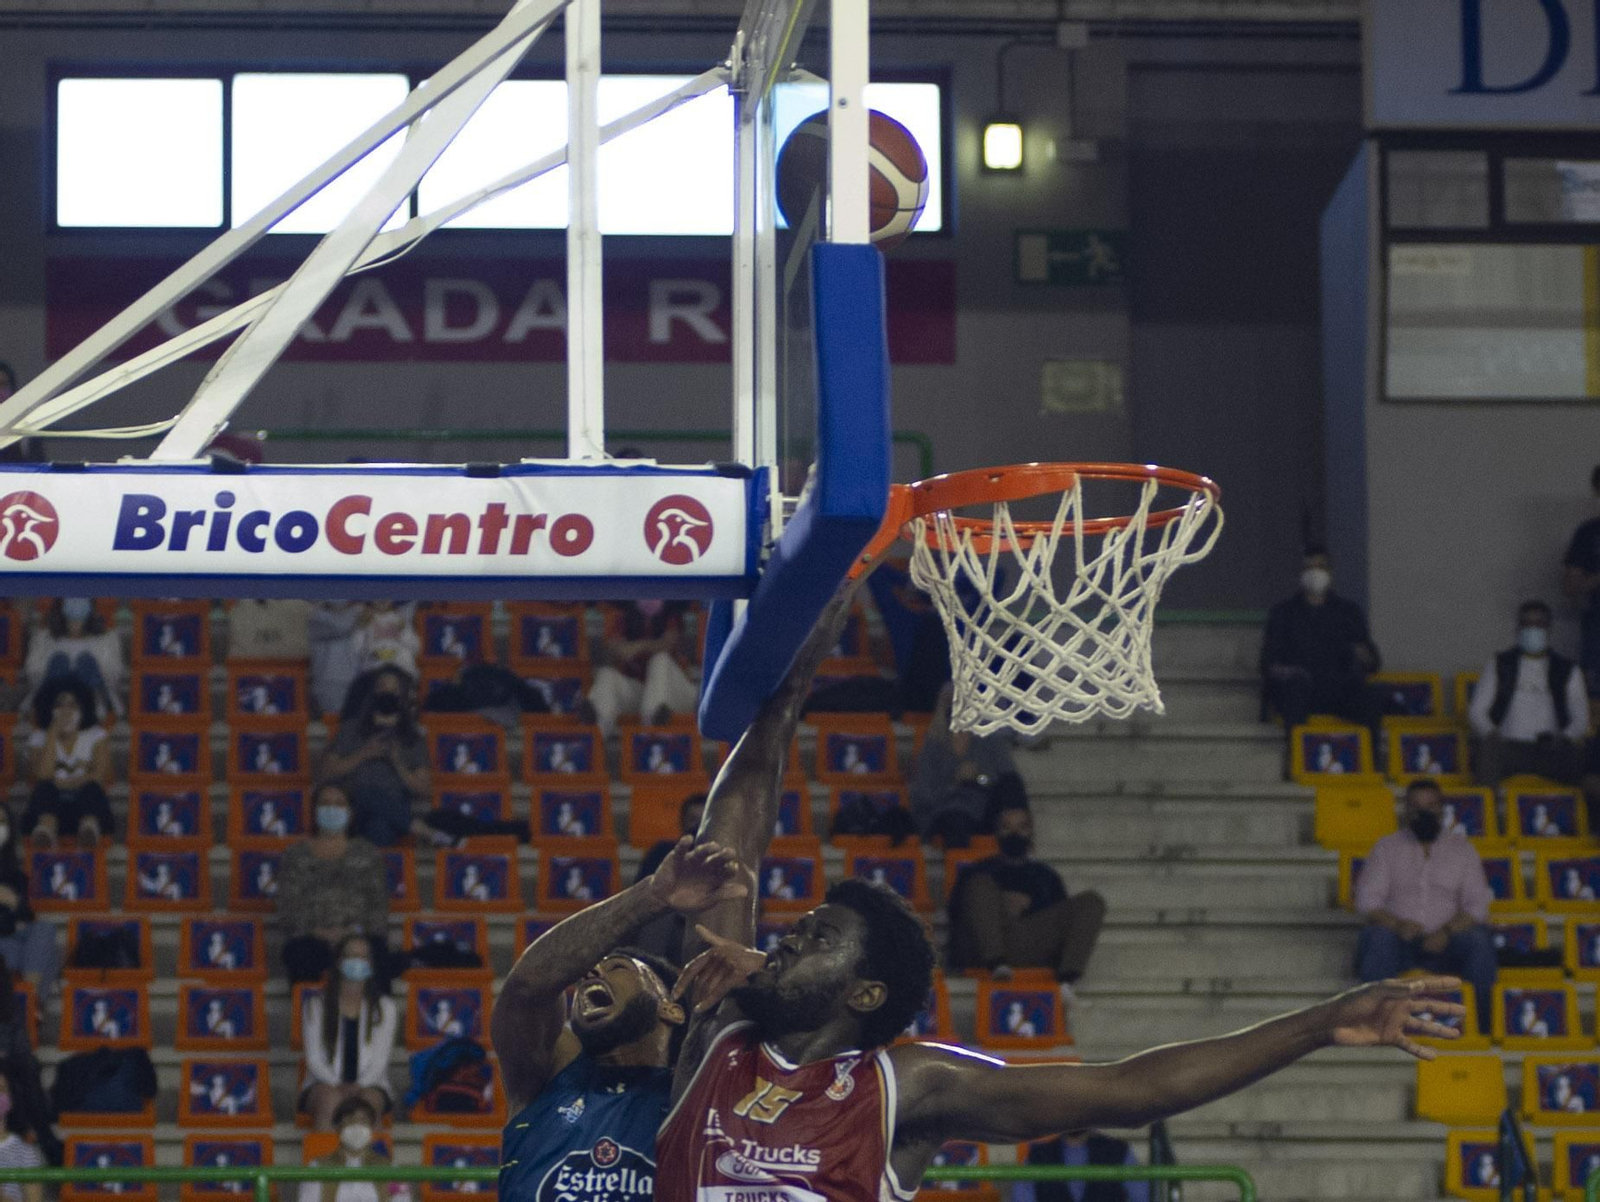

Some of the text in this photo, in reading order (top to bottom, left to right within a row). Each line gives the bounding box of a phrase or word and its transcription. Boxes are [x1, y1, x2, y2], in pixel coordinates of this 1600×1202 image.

[112, 491, 595, 556] BricoCentro
[741, 1139, 821, 1165] Trucks
[553, 1164, 654, 1195] Estrella
